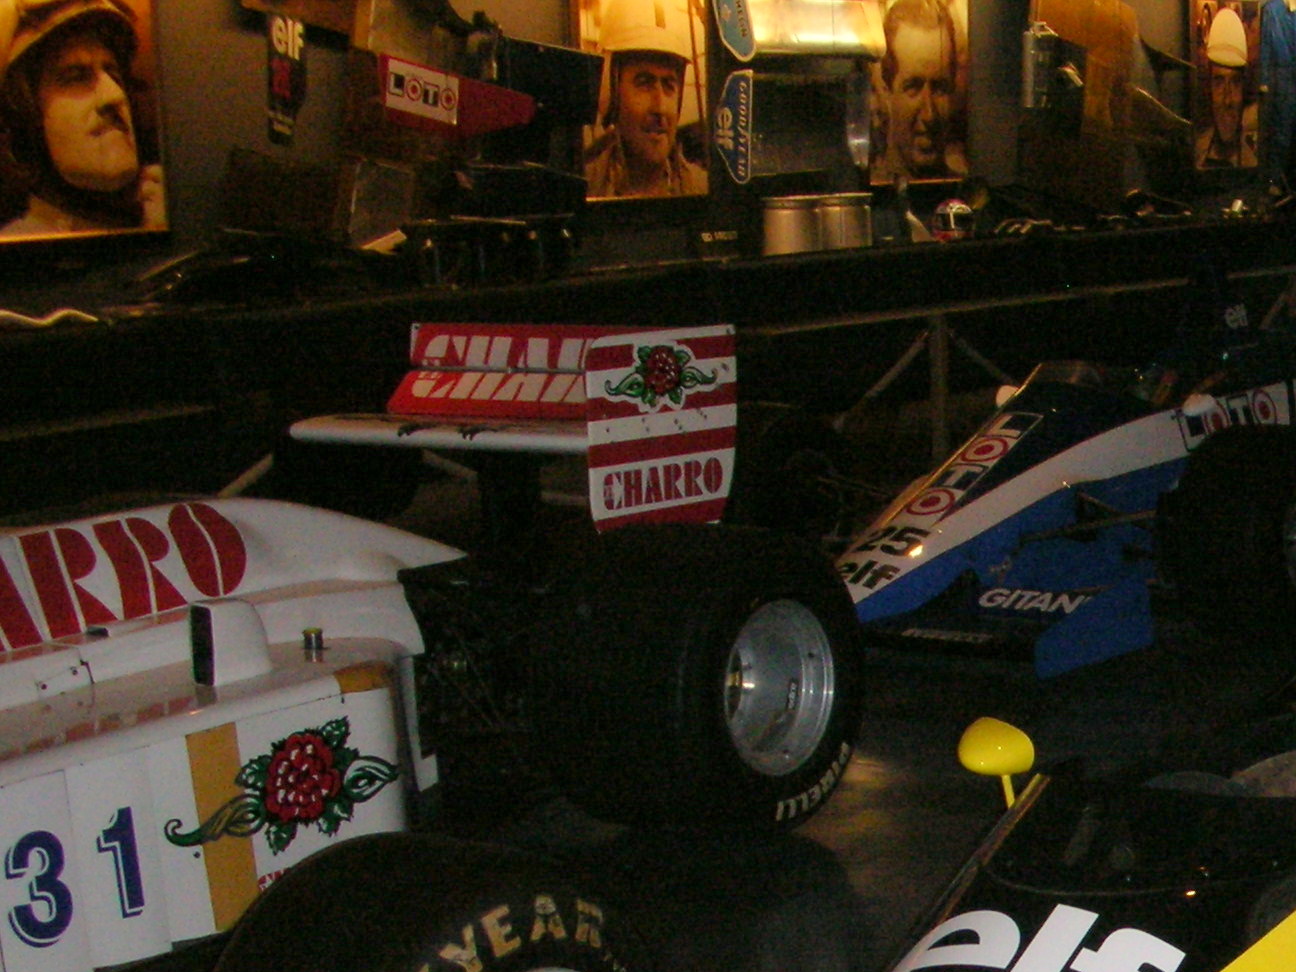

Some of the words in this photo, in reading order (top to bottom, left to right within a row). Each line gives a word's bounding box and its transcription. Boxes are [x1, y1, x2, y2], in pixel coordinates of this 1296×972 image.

[271, 15, 305, 60] elf
[387, 72, 458, 111] LOTO
[715, 107, 735, 151] elf
[603, 457, 723, 510] CHARRO
[905, 411, 1043, 516] LOTO
[978, 587, 1093, 614] GITAN
[4, 806, 145, 948] 31
